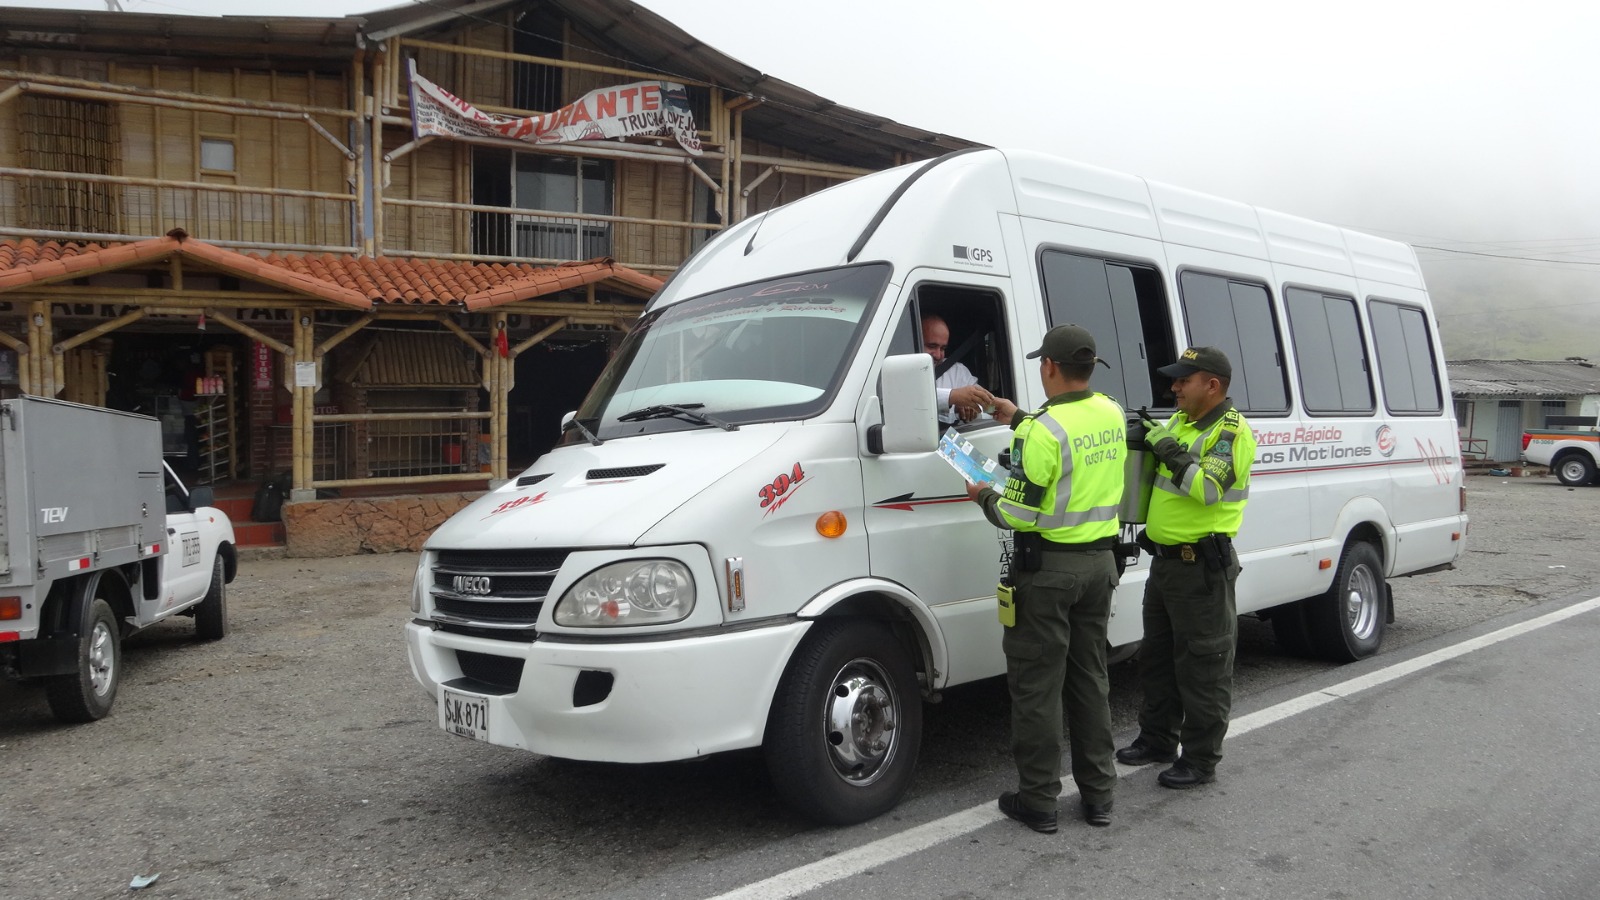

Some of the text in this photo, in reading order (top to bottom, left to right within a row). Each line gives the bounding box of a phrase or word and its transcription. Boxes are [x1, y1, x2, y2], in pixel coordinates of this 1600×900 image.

[972, 248, 993, 262] GPS
[1073, 427, 1125, 453] POLICIA
[1294, 425, 1343, 445] Rápido
[758, 462, 805, 508] 394
[1019, 481, 1027, 492] Y
[490, 491, 548, 514] 394
[452, 575, 491, 595] IVECO
